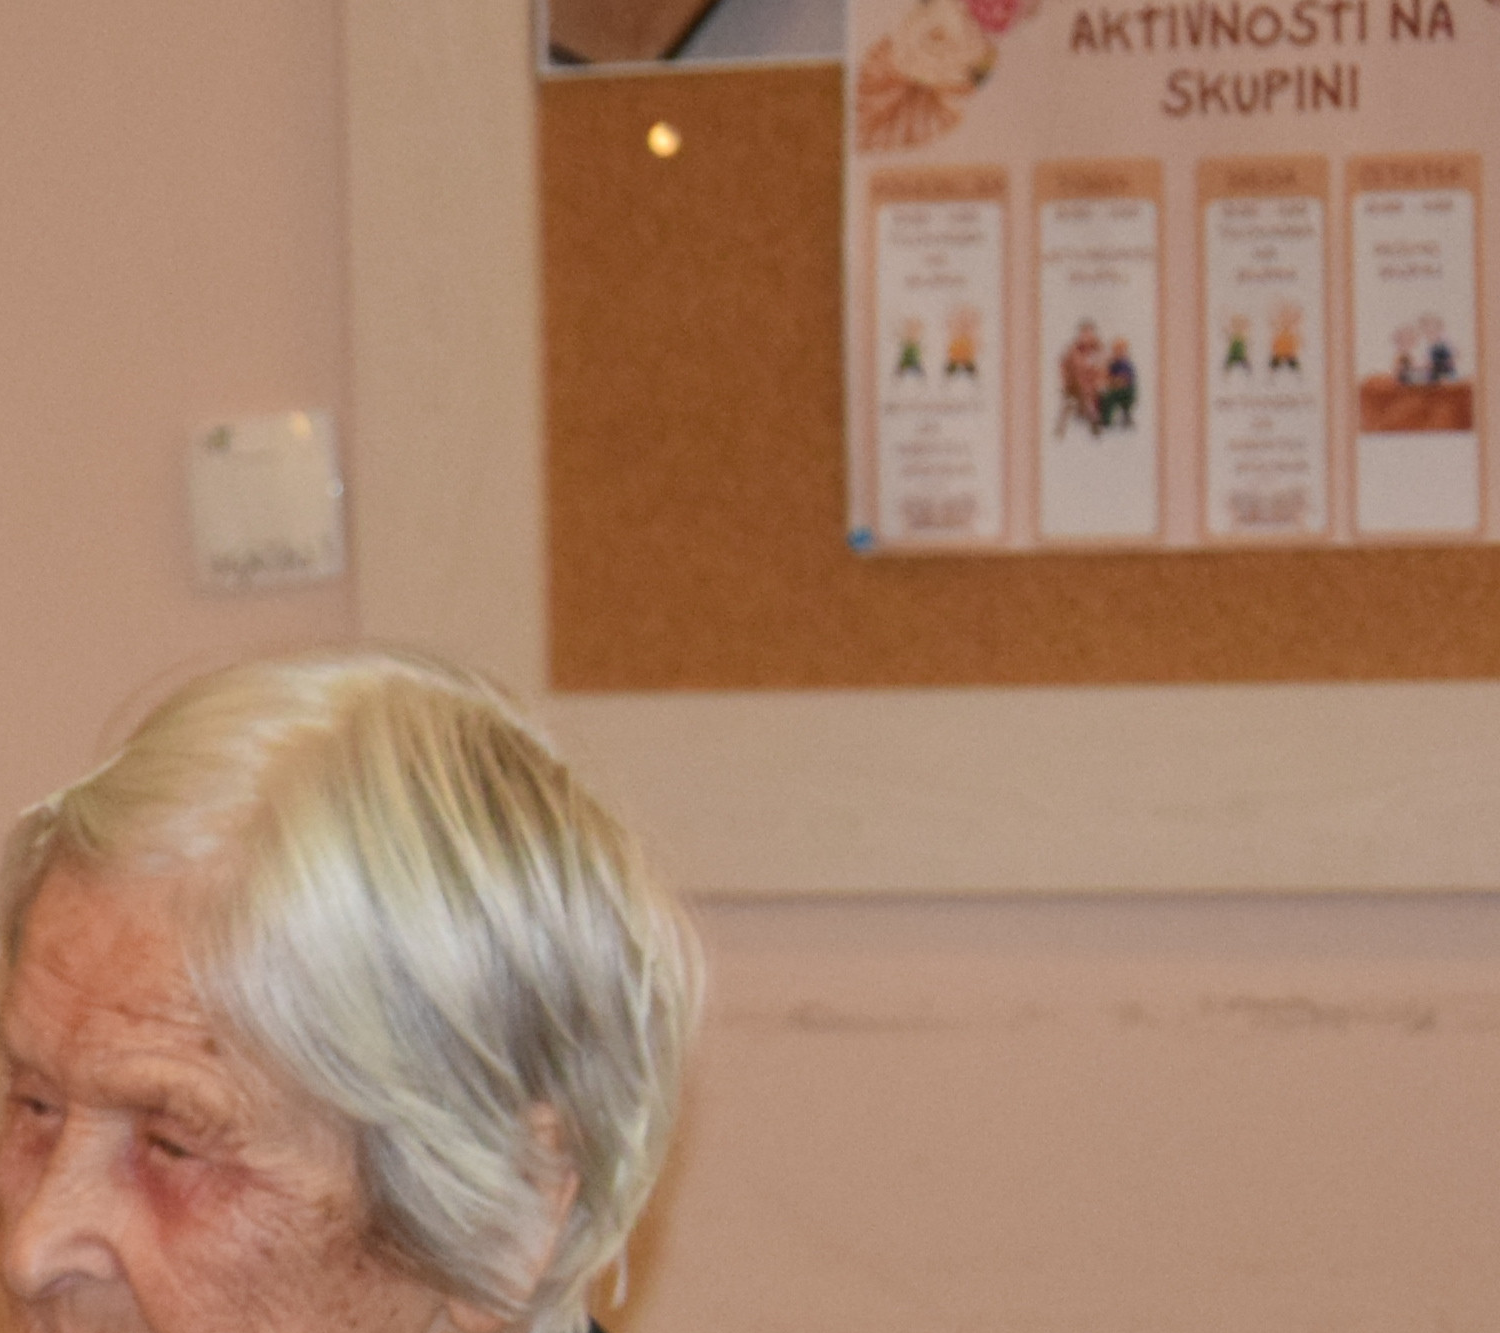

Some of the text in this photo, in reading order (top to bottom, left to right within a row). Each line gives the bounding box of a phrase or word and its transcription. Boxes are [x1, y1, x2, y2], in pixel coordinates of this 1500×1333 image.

[1068, 0, 1457, 54] AKTIVNOSTI NA
[1160, 62, 1361, 118] SKUPINI
